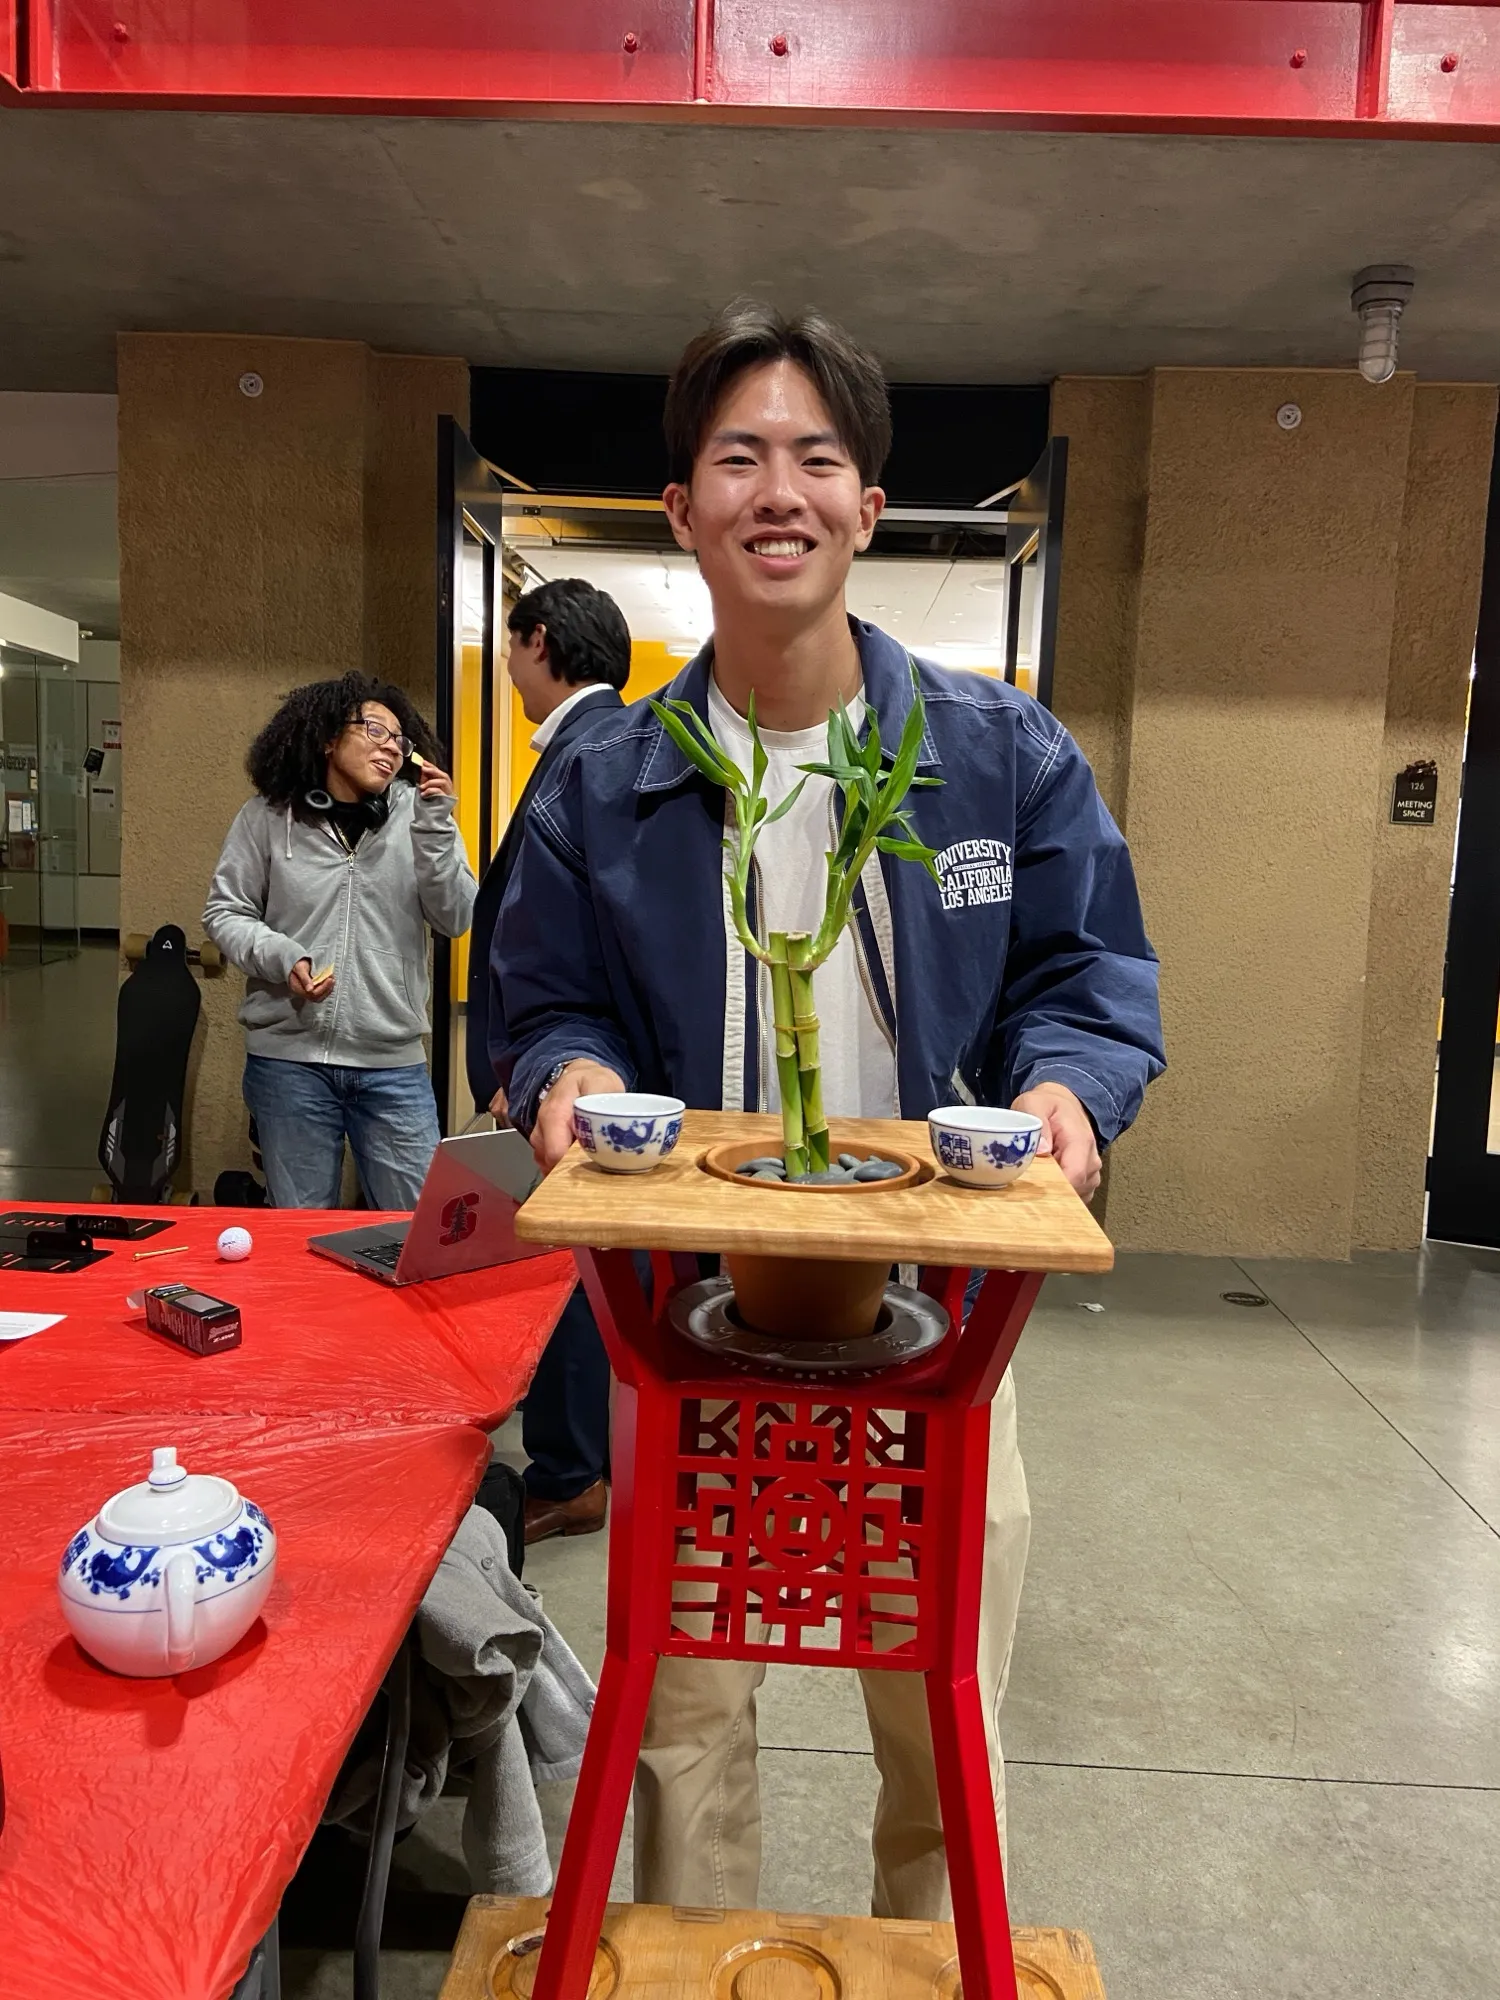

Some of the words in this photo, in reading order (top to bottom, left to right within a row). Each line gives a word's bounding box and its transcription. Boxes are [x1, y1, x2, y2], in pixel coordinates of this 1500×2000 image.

[1411, 782, 1425, 791] 126
[1397, 800, 1433, 809] MEETING
[1402, 810, 1426, 818] SPACE
[934, 838, 1012, 876] UNIVERSITY
[938, 864, 1013, 893] CALIFORNIA
[940, 890, 964, 910] LOS
[967, 883, 1013, 906] ANGELES
